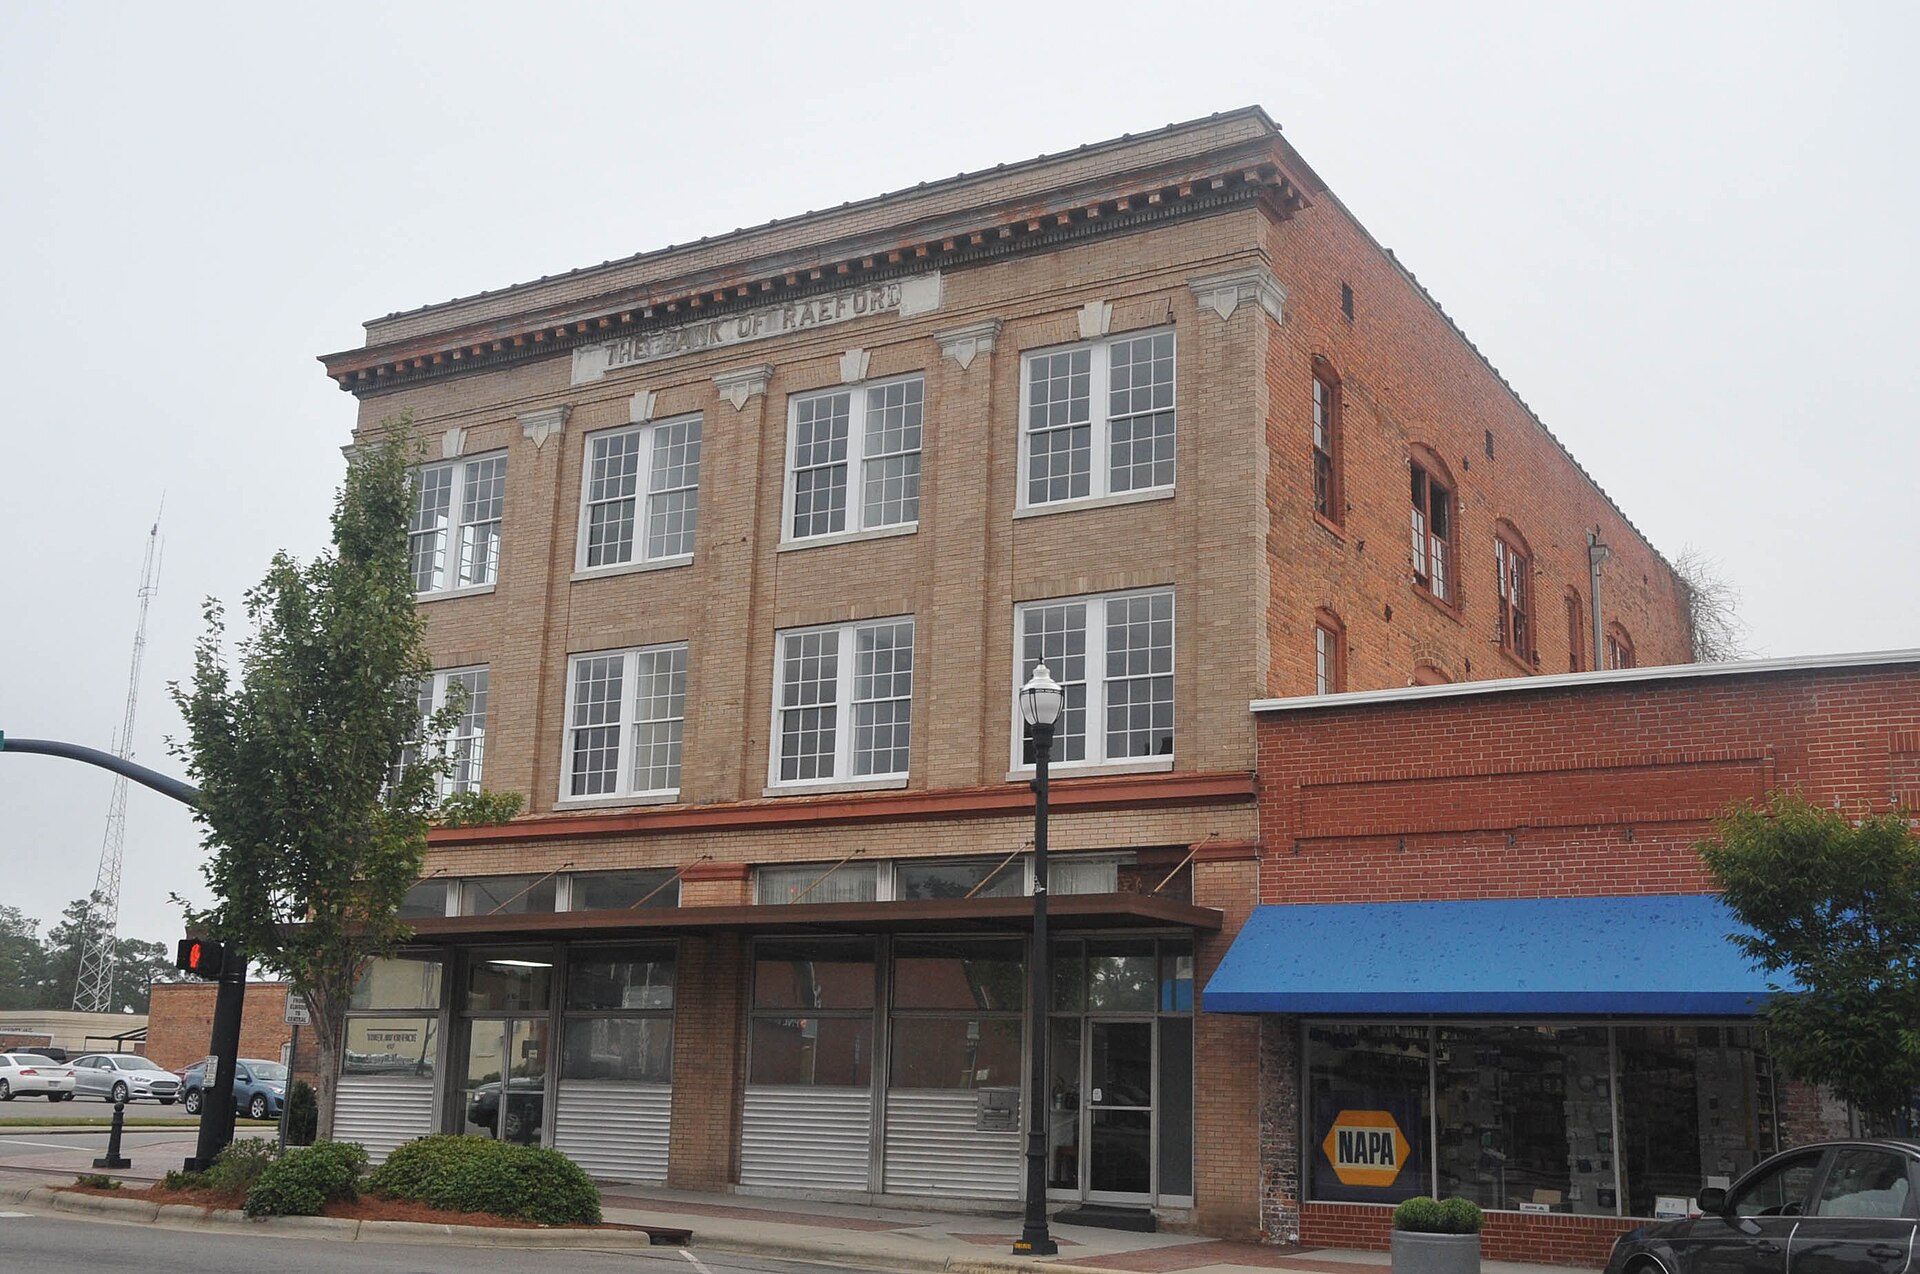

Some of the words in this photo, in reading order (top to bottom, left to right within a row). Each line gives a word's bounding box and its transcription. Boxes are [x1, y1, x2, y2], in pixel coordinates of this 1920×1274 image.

[604, 337, 649, 366] THE
[661, 324, 722, 354] BANK
[737, 312, 768, 339] OF
[783, 283, 903, 330] RAEFORD
[394, 1033, 417, 1042] OFFICE
[1339, 1131, 1394, 1166] NAPA
